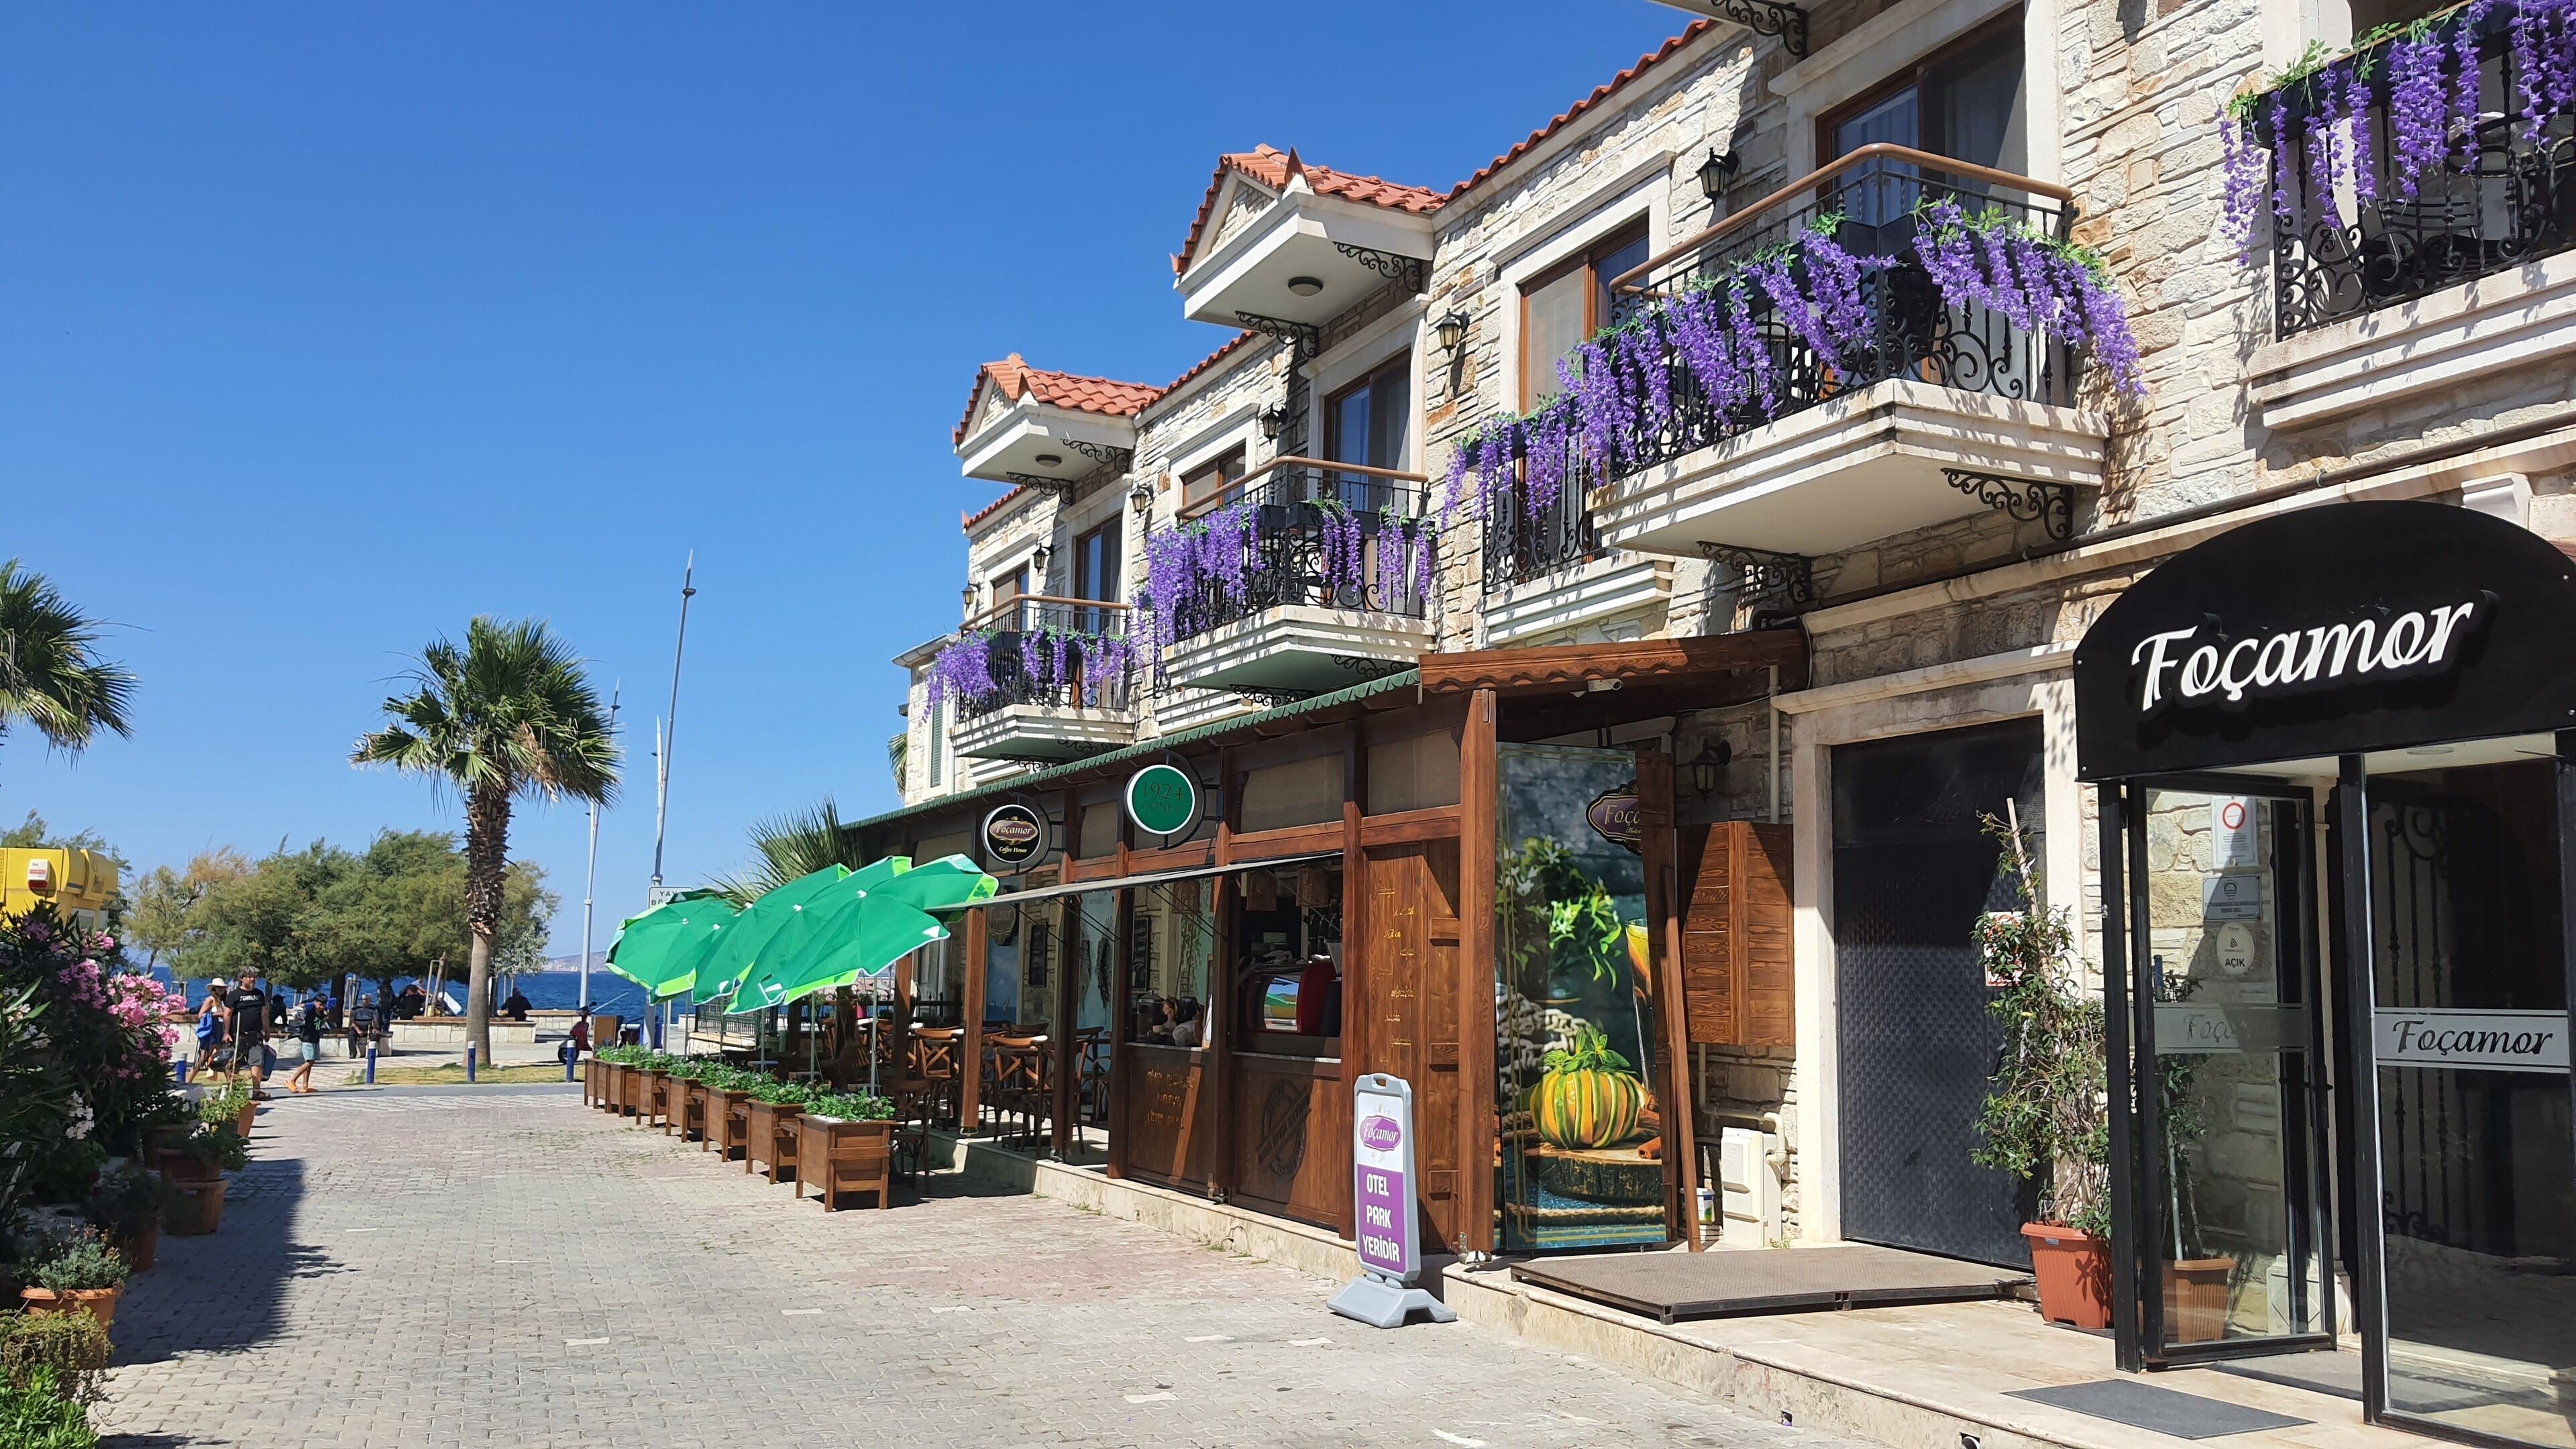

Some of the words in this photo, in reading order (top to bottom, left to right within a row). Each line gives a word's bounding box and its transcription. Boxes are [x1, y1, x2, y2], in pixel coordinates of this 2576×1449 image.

[2132, 602, 2474, 712] Foçamor
[1143, 782, 1182, 800] 1924
[996, 824, 1033, 836] Foçamor
[2224, 957, 2245, 969] AÇIK
[2392, 1020, 2553, 1055] Foçamor
[1362, 1122, 1401, 1144] Foçamor
[1366, 1173, 1390, 1196] OTEL
[1366, 1204, 1392, 1230] PARK
[1362, 1234, 1401, 1263] YERİDİR
